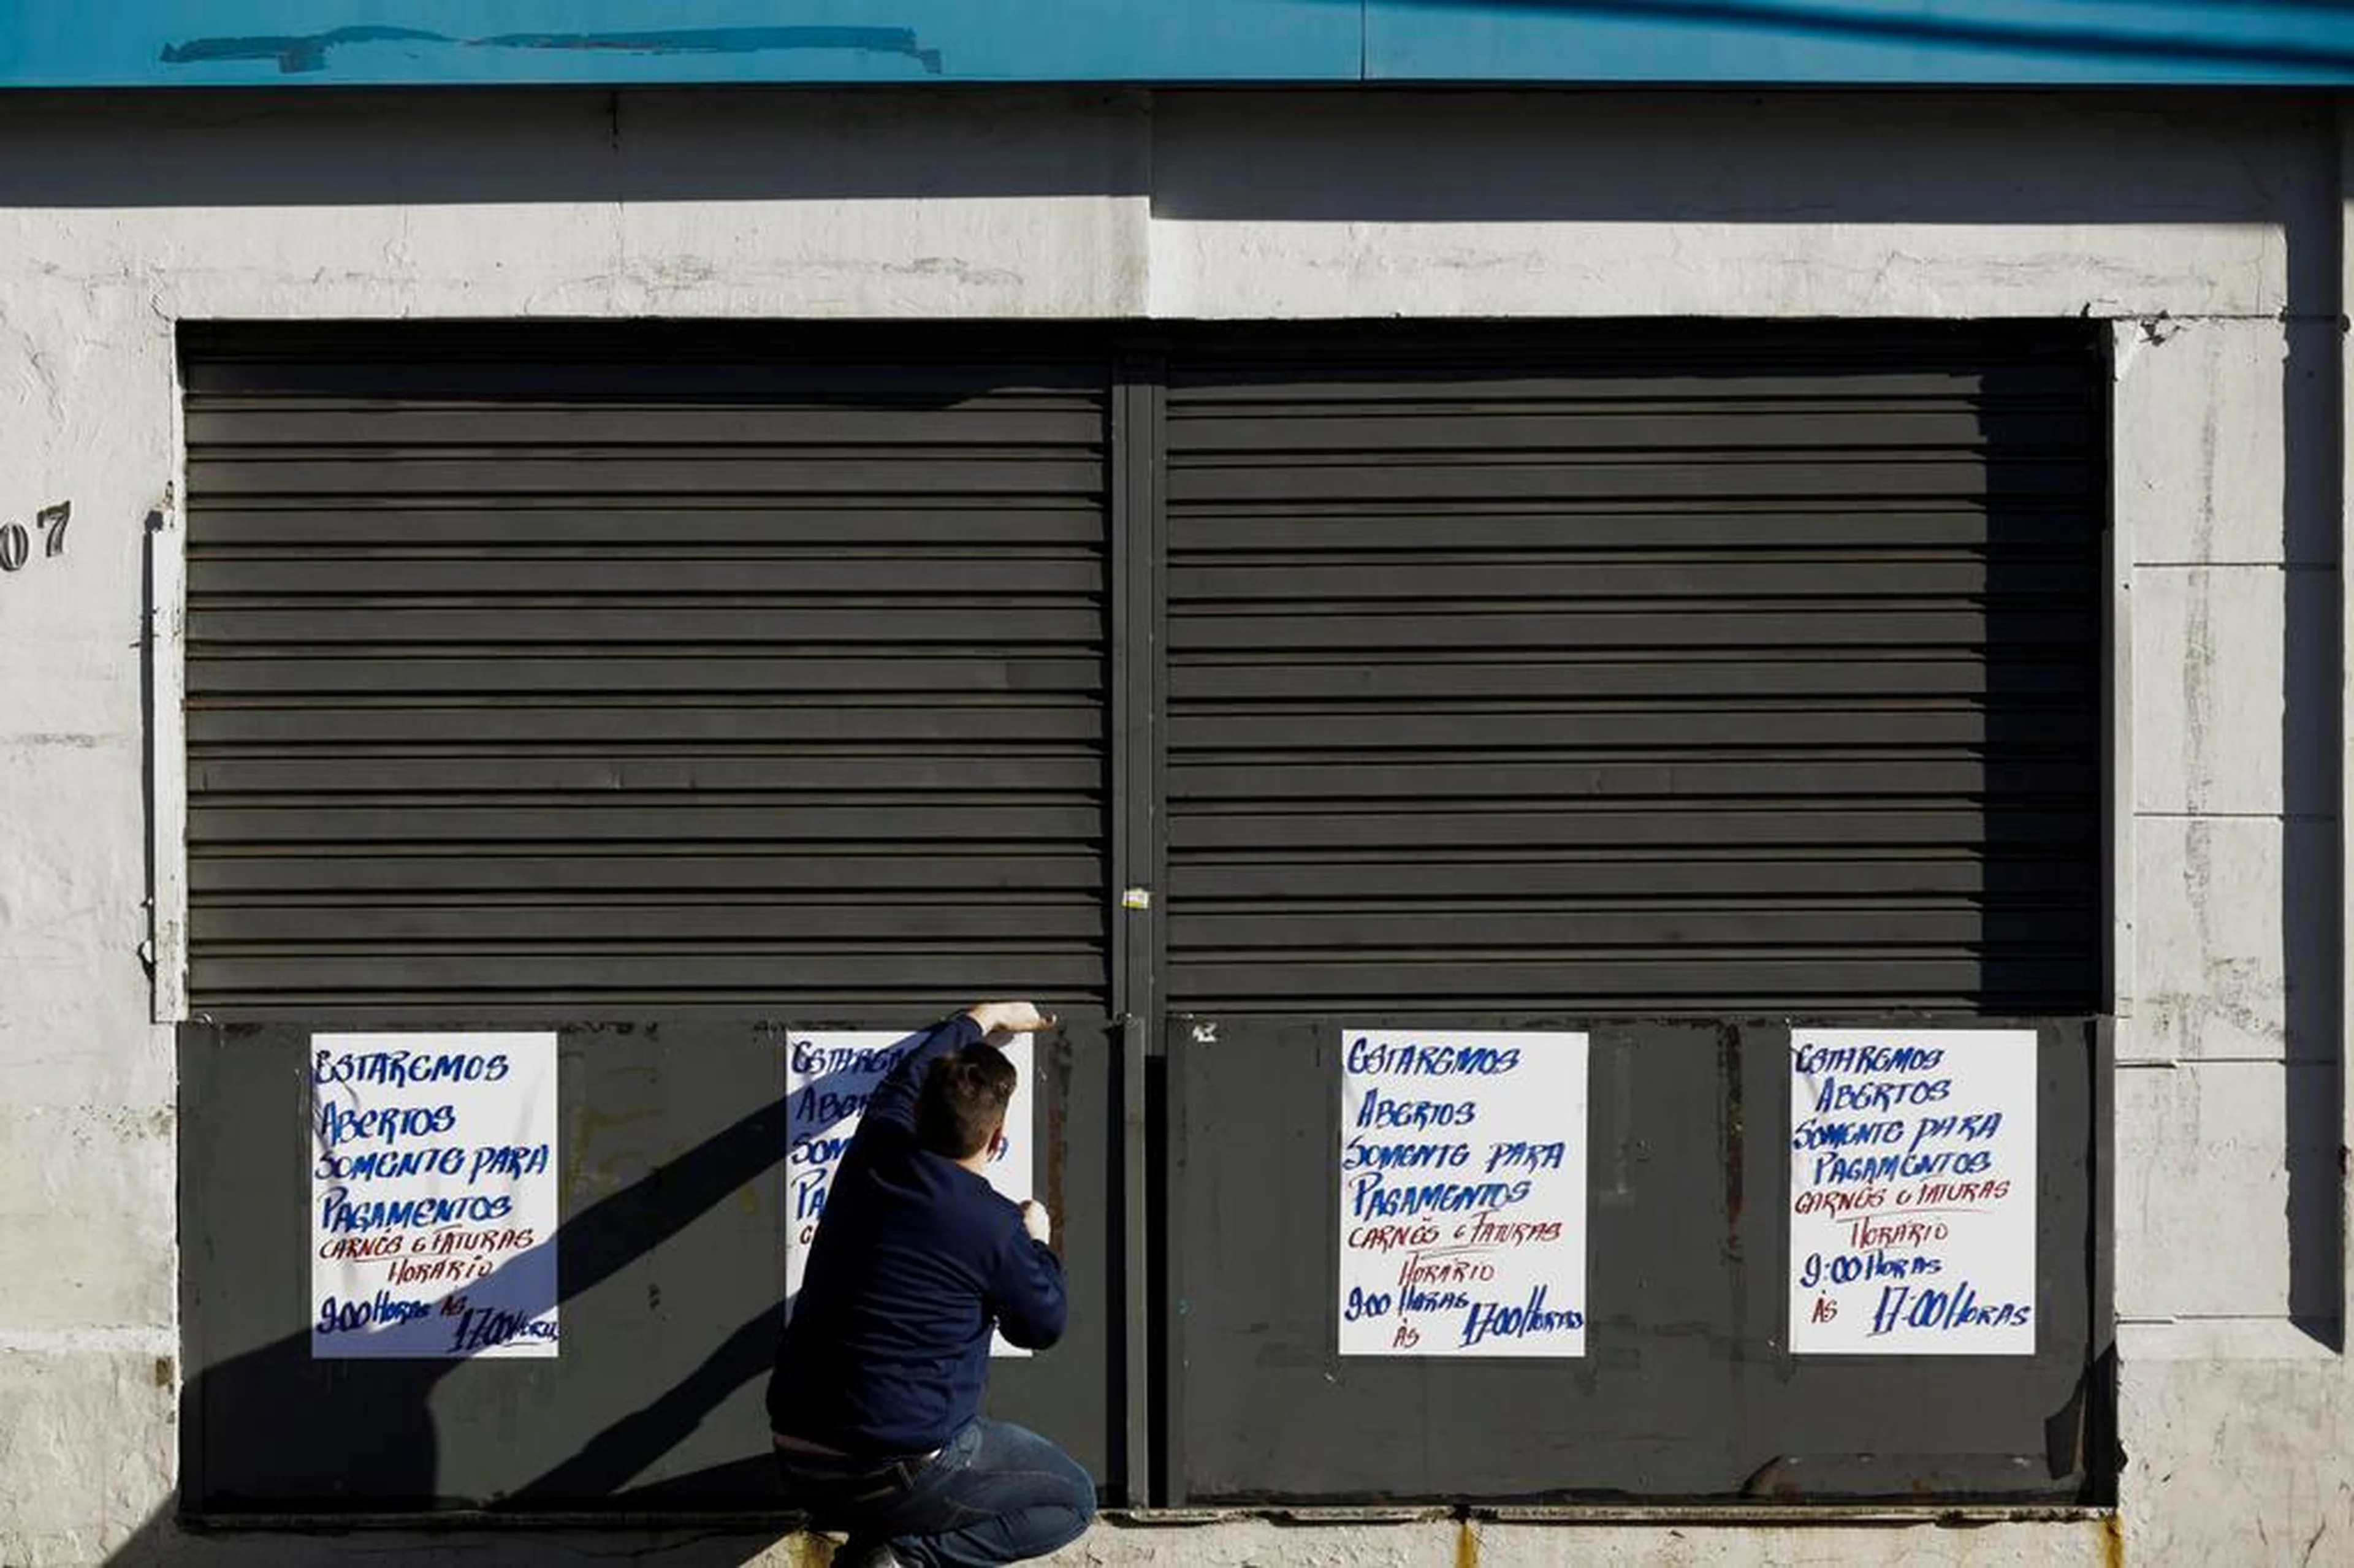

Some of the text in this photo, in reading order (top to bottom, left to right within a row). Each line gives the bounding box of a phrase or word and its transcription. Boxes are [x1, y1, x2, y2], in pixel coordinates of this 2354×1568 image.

[315, 1049, 509, 1087] ESTAREMOS
[1348, 1037, 1521, 1076] ESTAREMOS
[1796, 1043, 1946, 1075] ESTAREMOS
[1356, 1087, 1476, 1132] ABERTOS
[1815, 1076, 1952, 1113] ABERTOS
[321, 1101, 456, 1146] ABERTOS
[1793, 1111, 2004, 1154] SOMENTE PARA
[314, 1144, 549, 1184] SOMENTE PARA
[1343, 1135, 1566, 1174] SOMENTE PARA
[1813, 1151, 1993, 1186] PAGAMENTOS
[319, 1186, 512, 1233] PAGAMENTOS
[1348, 1171, 1533, 1222] PAGAMENTOS
